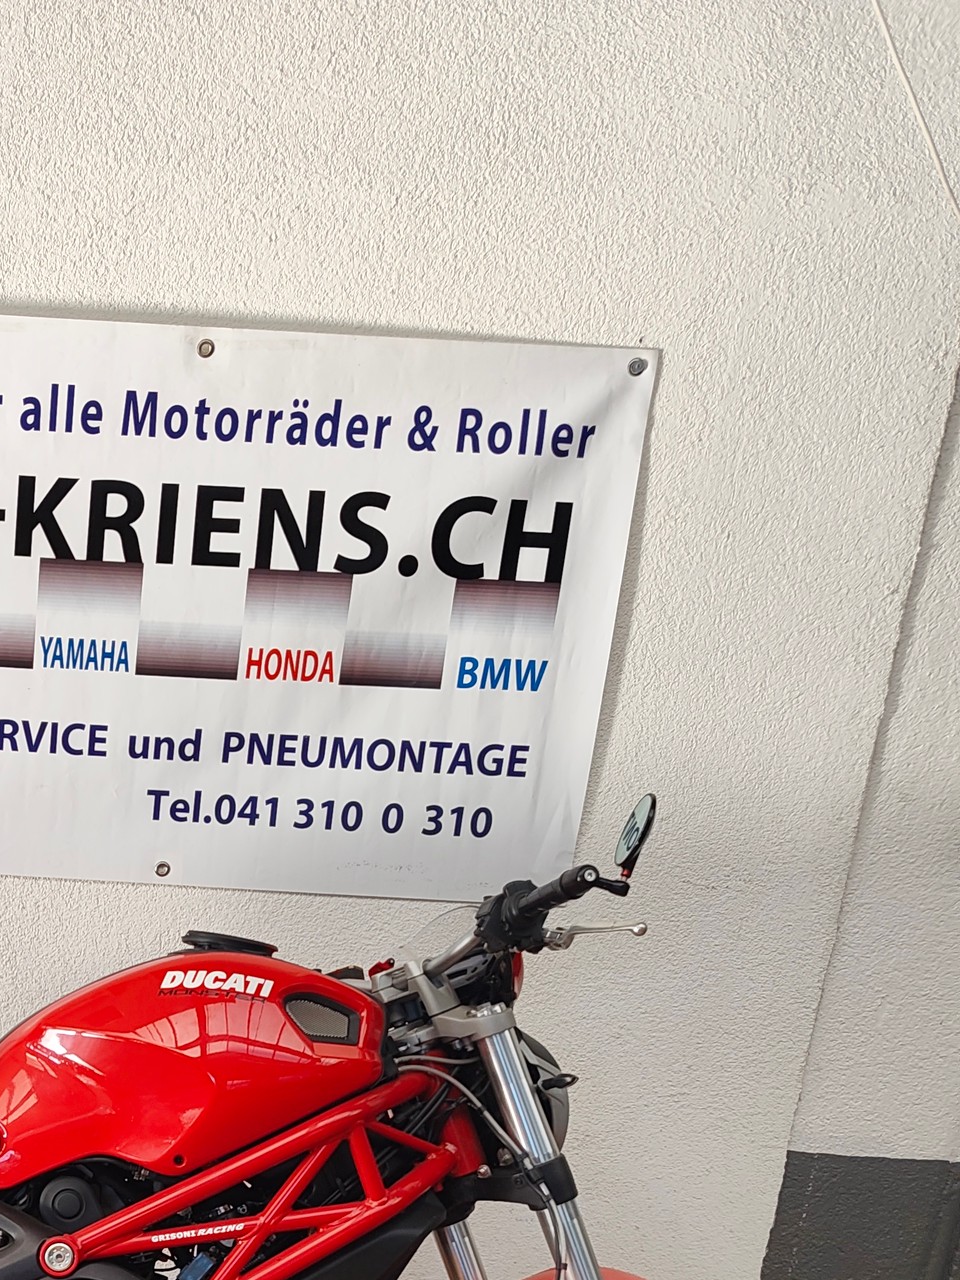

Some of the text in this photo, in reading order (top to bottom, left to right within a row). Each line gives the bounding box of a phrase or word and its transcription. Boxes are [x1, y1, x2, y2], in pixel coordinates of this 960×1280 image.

[21, 384, 102, 434] alle
[122, 391, 391, 448] Motorräder
[408, 406, 438, 451] &
[457, 409, 596, 458] Roller
[41, 637, 128, 672] YAMAHA
[246, 648, 333, 682] HONDA
[457, 657, 548, 691] BMW
[129, 729, 202, 761] und
[222, 732, 529, 777] PNEUMONTAGE
[147, 790, 492, 838] Tel.041 310 0 310
[160, 970, 274, 998] DUCATI
[151, 1223, 244, 1242] GRISONI RACING
